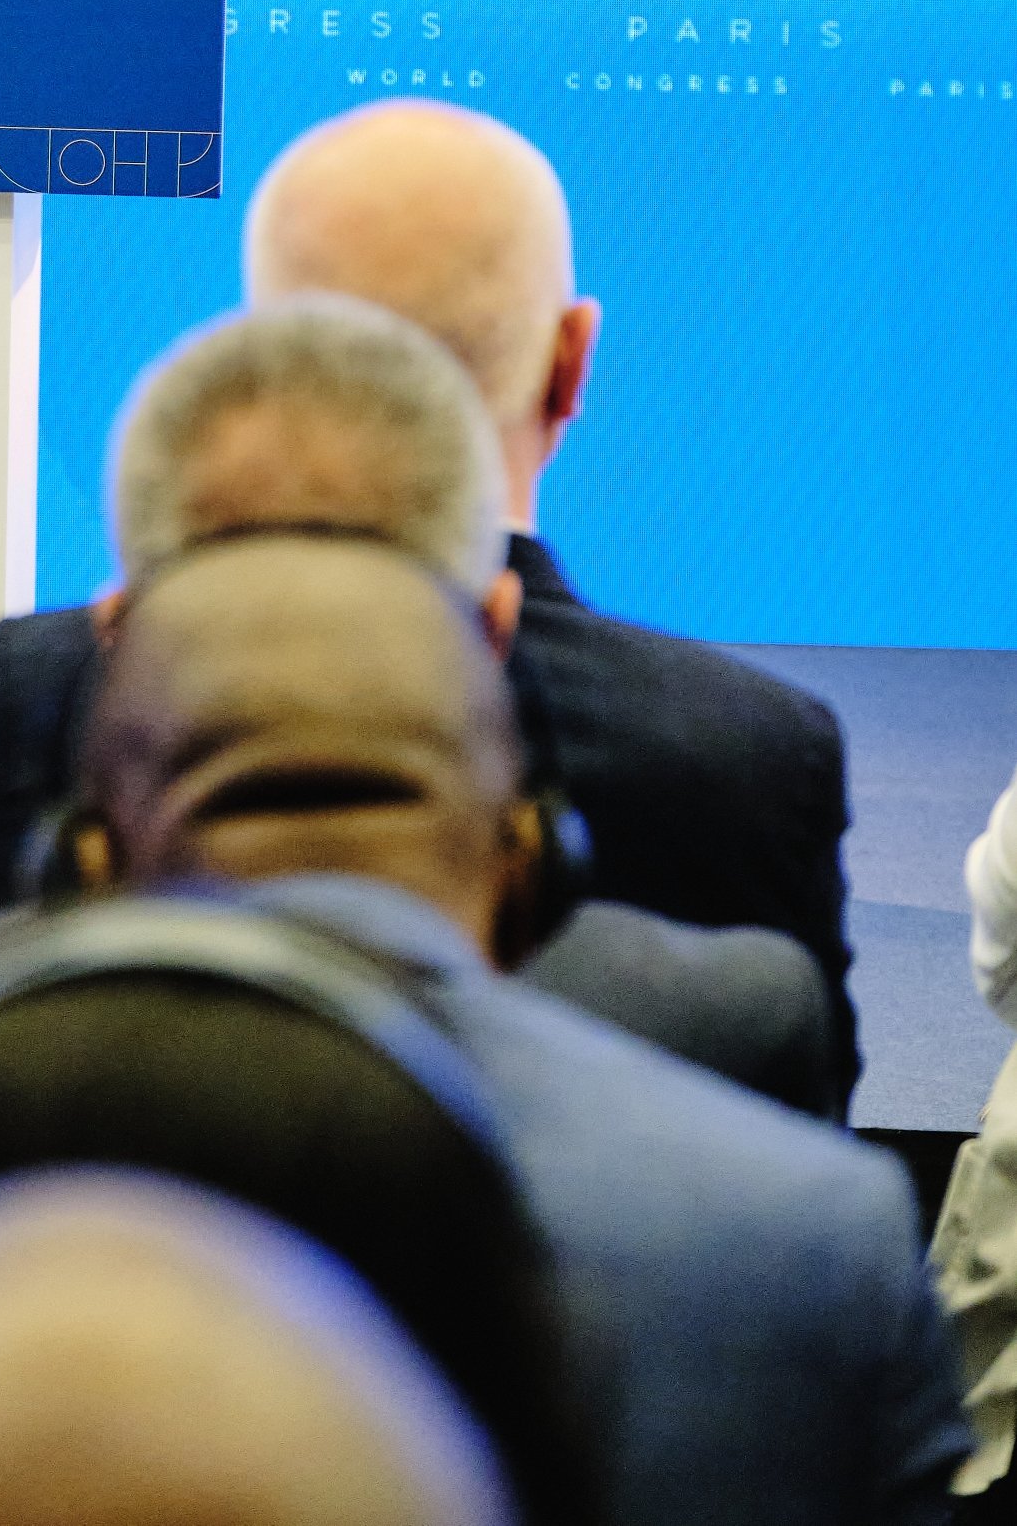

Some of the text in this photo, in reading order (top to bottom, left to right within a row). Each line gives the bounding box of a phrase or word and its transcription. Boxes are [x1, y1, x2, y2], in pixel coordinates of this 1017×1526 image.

[225, 7, 842, 48] GRESS PARIS
[347, 68, 484, 88] WORLD
[566, 72, 788, 95] CONGRESS
